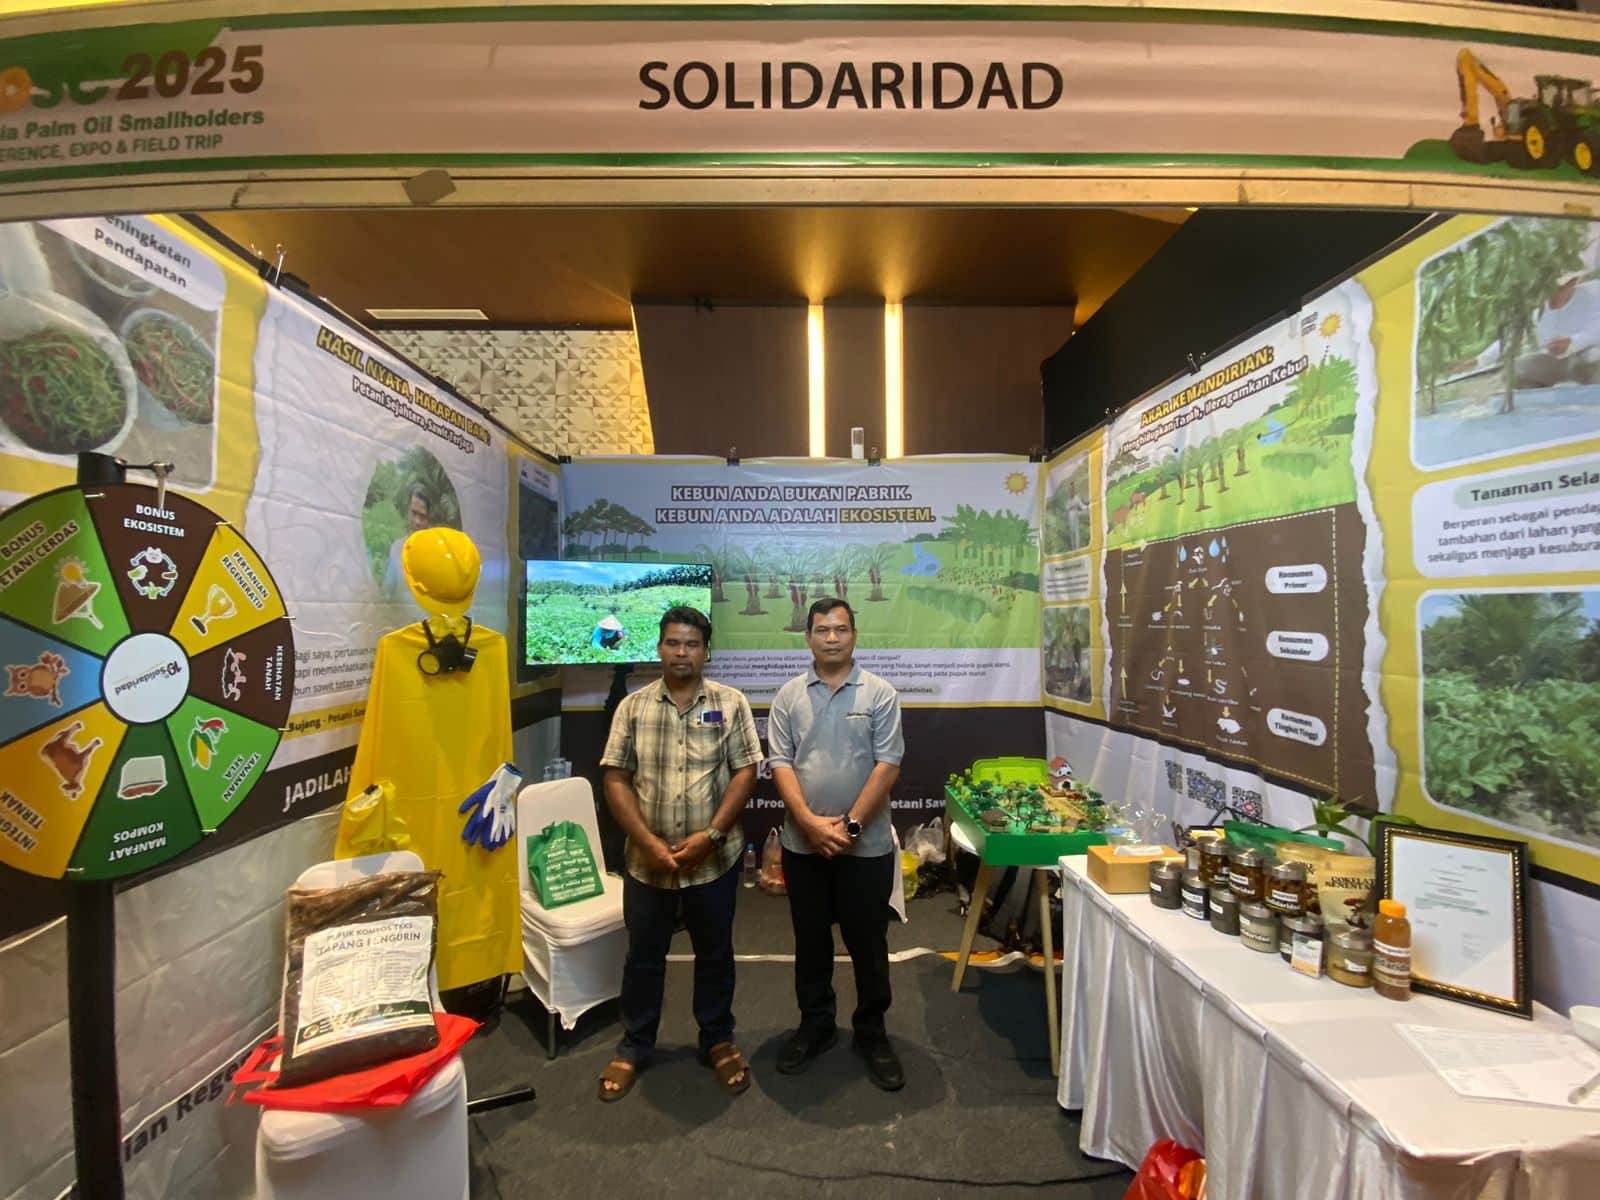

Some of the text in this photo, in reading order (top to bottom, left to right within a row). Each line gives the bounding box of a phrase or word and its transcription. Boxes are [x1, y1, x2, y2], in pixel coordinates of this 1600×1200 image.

[116, 44, 264, 100] 2025
[638, 61, 1063, 110] SOLIDARIDAD
[25, 121, 76, 139] Palm
[83, 115, 113, 134] Oil
[119, 109, 264, 132] Smallholders
[69, 140, 112, 157] EXPO
[116, 138, 128, 154] &
[133, 136, 180, 152] FIELD
[184, 134, 223, 149] TRIP
[103, 213, 191, 268] eningkatan
[95, 227, 187, 288] Pendapatan
[317, 325, 363, 371] HASIL
[366, 357, 414, 404] NYATA,
[415, 386, 465, 430] HARAPAN
[353, 375, 386, 407] Petani
[1140, 346, 1274, 428] AKAR KEMANDIRIAN:
[672, 485, 912, 500] KEBUN ANDA BUKAN PABRIK.
[1471, 472, 1600, 501] Tanaman Sela
[136, 504, 176, 520] BONUS
[656, 507, 936, 523] KEBUN ANDA ADALAH EKOSISTEM.
[1443, 516, 1496, 530] Berperan
[1498, 509, 1549, 523] sebagai
[0, 521, 45, 558] BONUS
[35, 521, 79, 557] CERDAS
[123, 518, 185, 537] EKOSISTEM
[1438, 531, 1496, 546] tambahan
[1499, 528, 1525, 541] dari
[1528, 525, 1568, 538] lahan
[1428, 548, 1478, 563] sekaligus
[1482, 546, 1535, 561] menjaga
[222, 556, 263, 609] REGENERATIF
[233, 551, 269, 598] PERTANIAN
[264, 656, 273, 690] TANAH
[274, 645, 284, 700] KESEHATAN
[223, 753, 260, 801] TANAMAN
[225, 755, 244, 779] SELA
[891, 799, 923, 809] etani
[113, 821, 164, 843] KOMPOS
[108, 836, 166, 861] MANFAAT
[367, 931, 421, 947] NGURIN
